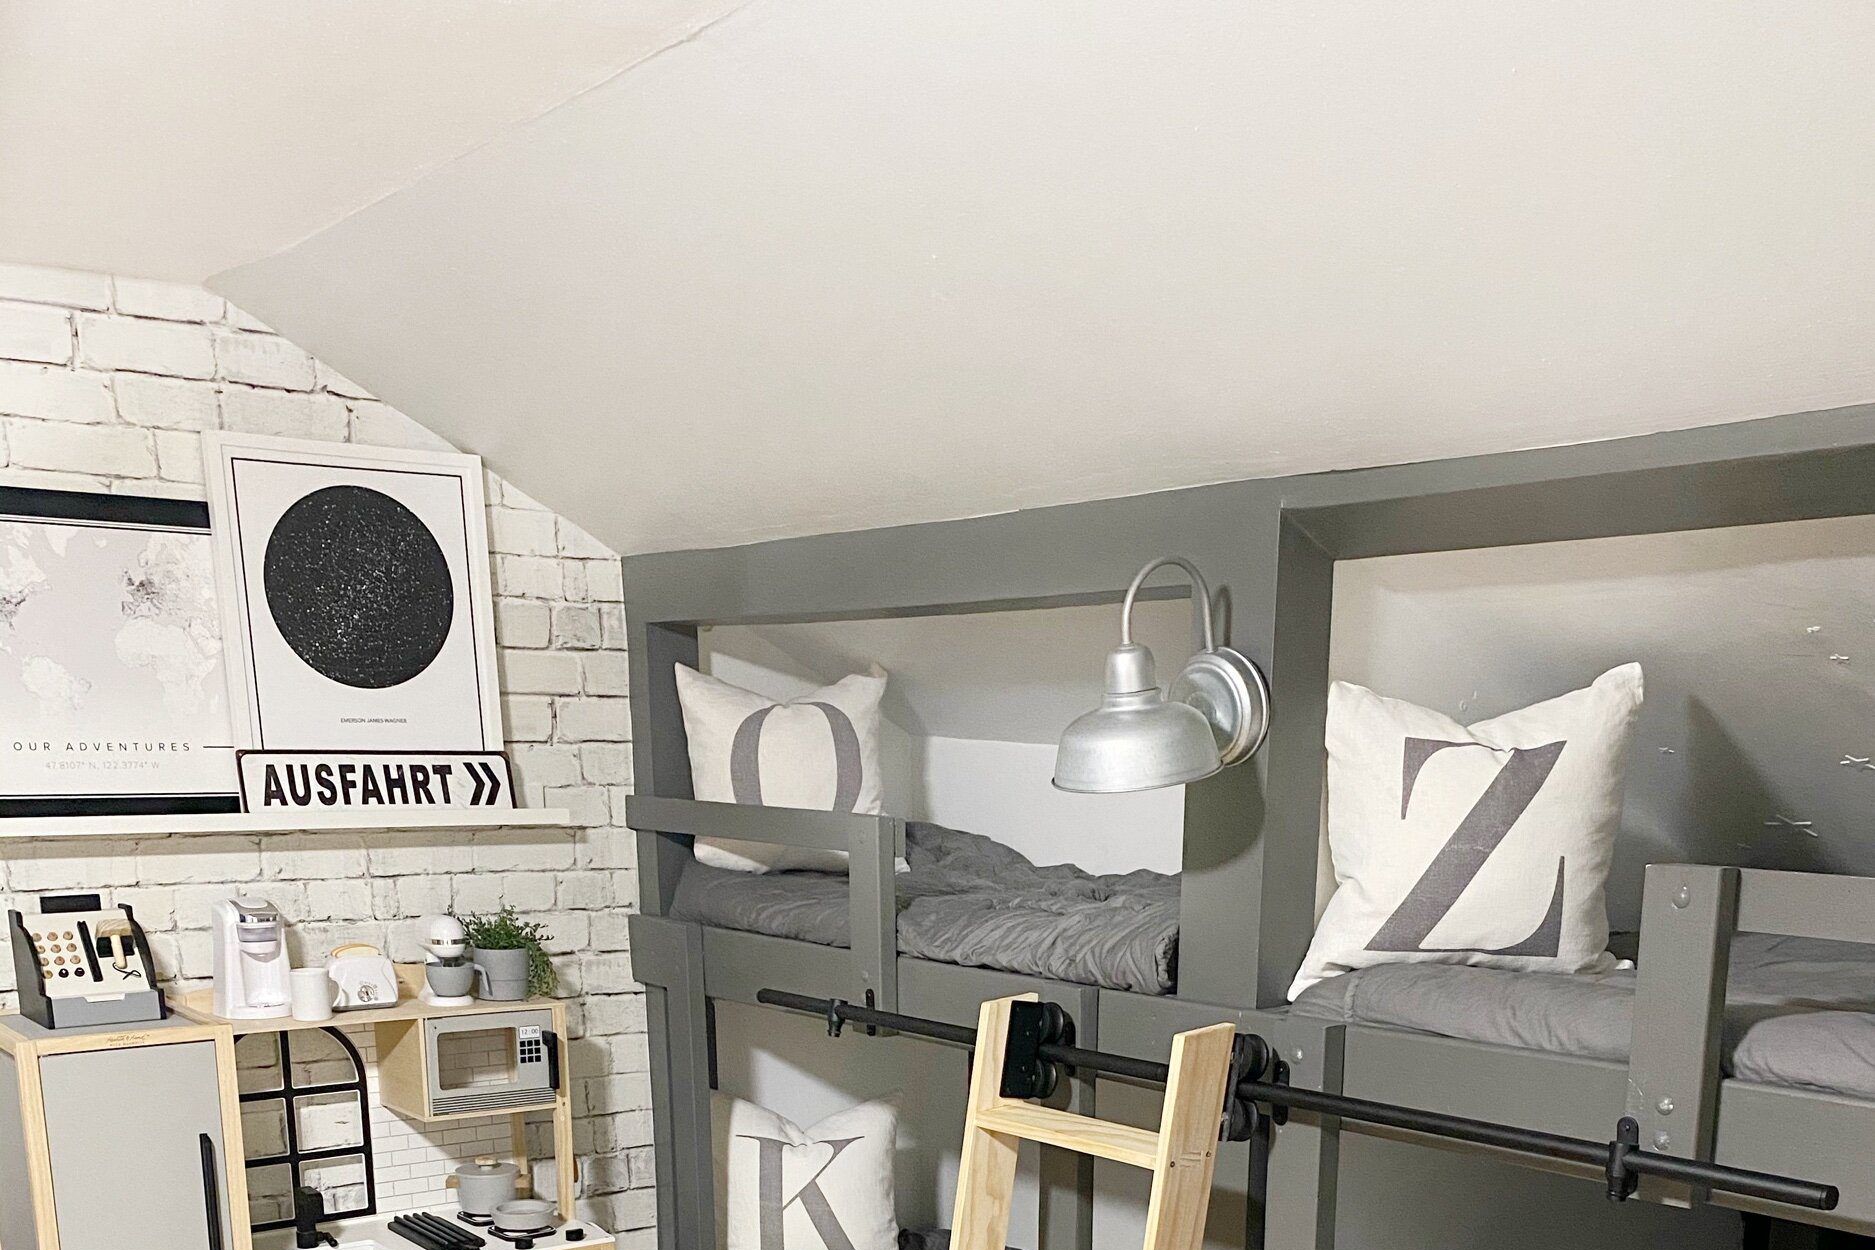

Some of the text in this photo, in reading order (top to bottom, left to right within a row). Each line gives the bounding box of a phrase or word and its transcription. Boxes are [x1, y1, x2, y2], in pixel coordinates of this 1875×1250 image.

[12, 741, 191, 751] OUR ADVENTURES
[151, 761, 160, 769] W
[263, 763, 453, 807] AUSFAHRT
[1363, 736, 1568, 958] Z
